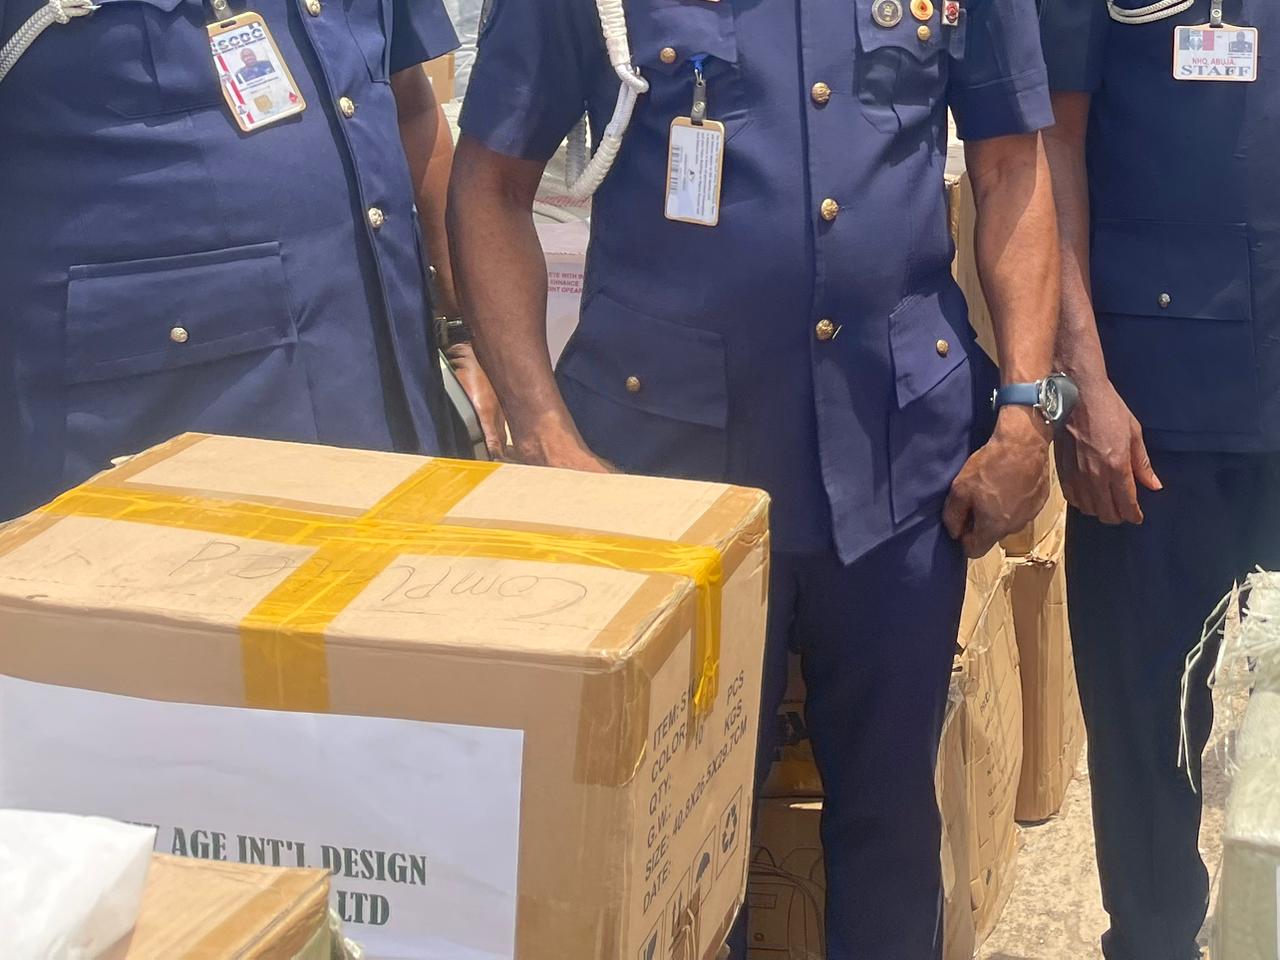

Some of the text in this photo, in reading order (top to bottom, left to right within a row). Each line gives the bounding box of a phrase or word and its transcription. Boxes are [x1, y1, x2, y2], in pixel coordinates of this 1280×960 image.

[1181, 65, 1251, 77] STAFF
[653, 703, 679, 752] ITEM:
[723, 698, 743, 736] KGS
[649, 772, 671, 816] QTY:
[726, 669, 744, 705] PCS
[171, 826, 227, 862] AGE
[320, 845, 427, 886] DESIGN
[645, 834, 669, 881] SIZE:
[336, 890, 390, 926] LTD
[643, 859, 671, 915] DATE:
